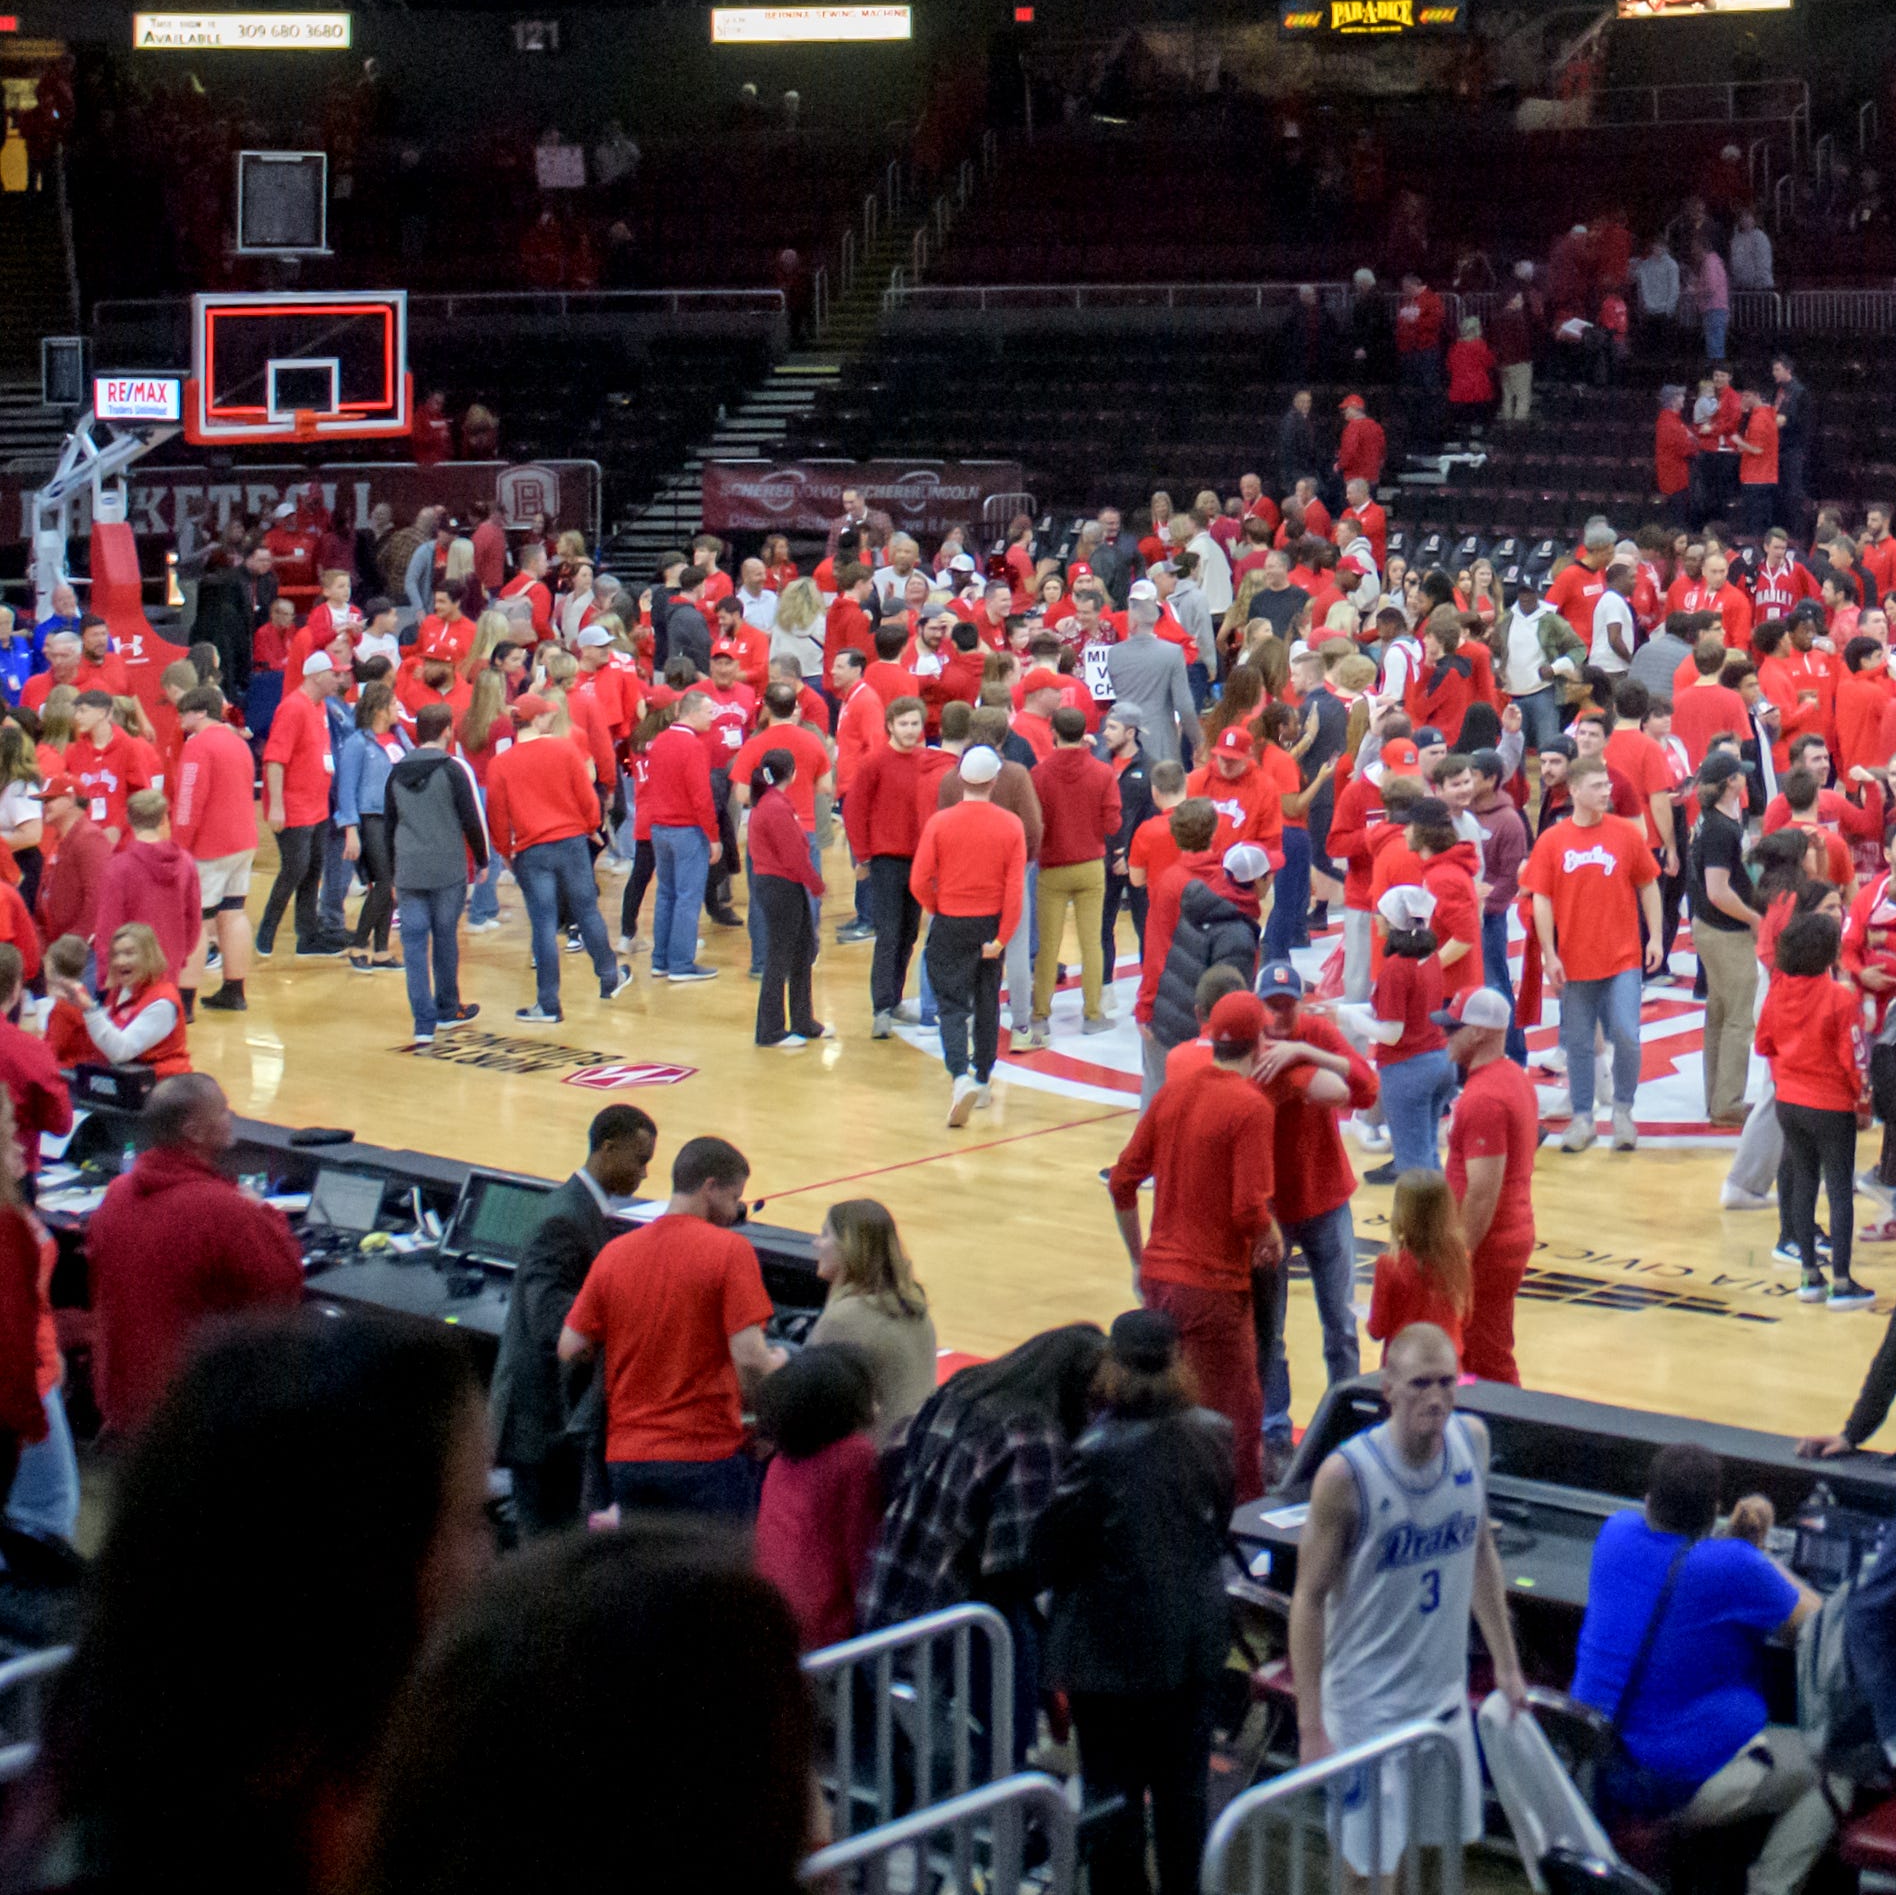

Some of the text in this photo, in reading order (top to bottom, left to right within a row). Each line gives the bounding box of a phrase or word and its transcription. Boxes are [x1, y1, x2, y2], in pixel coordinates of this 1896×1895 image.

[238, 24, 266, 39] 309
[306, 23, 344, 38] 3680
[108, 381, 167, 404] RE/MAX
[1375, 1510, 1477, 1574] Drake
[1419, 1568, 1441, 1615] 3
